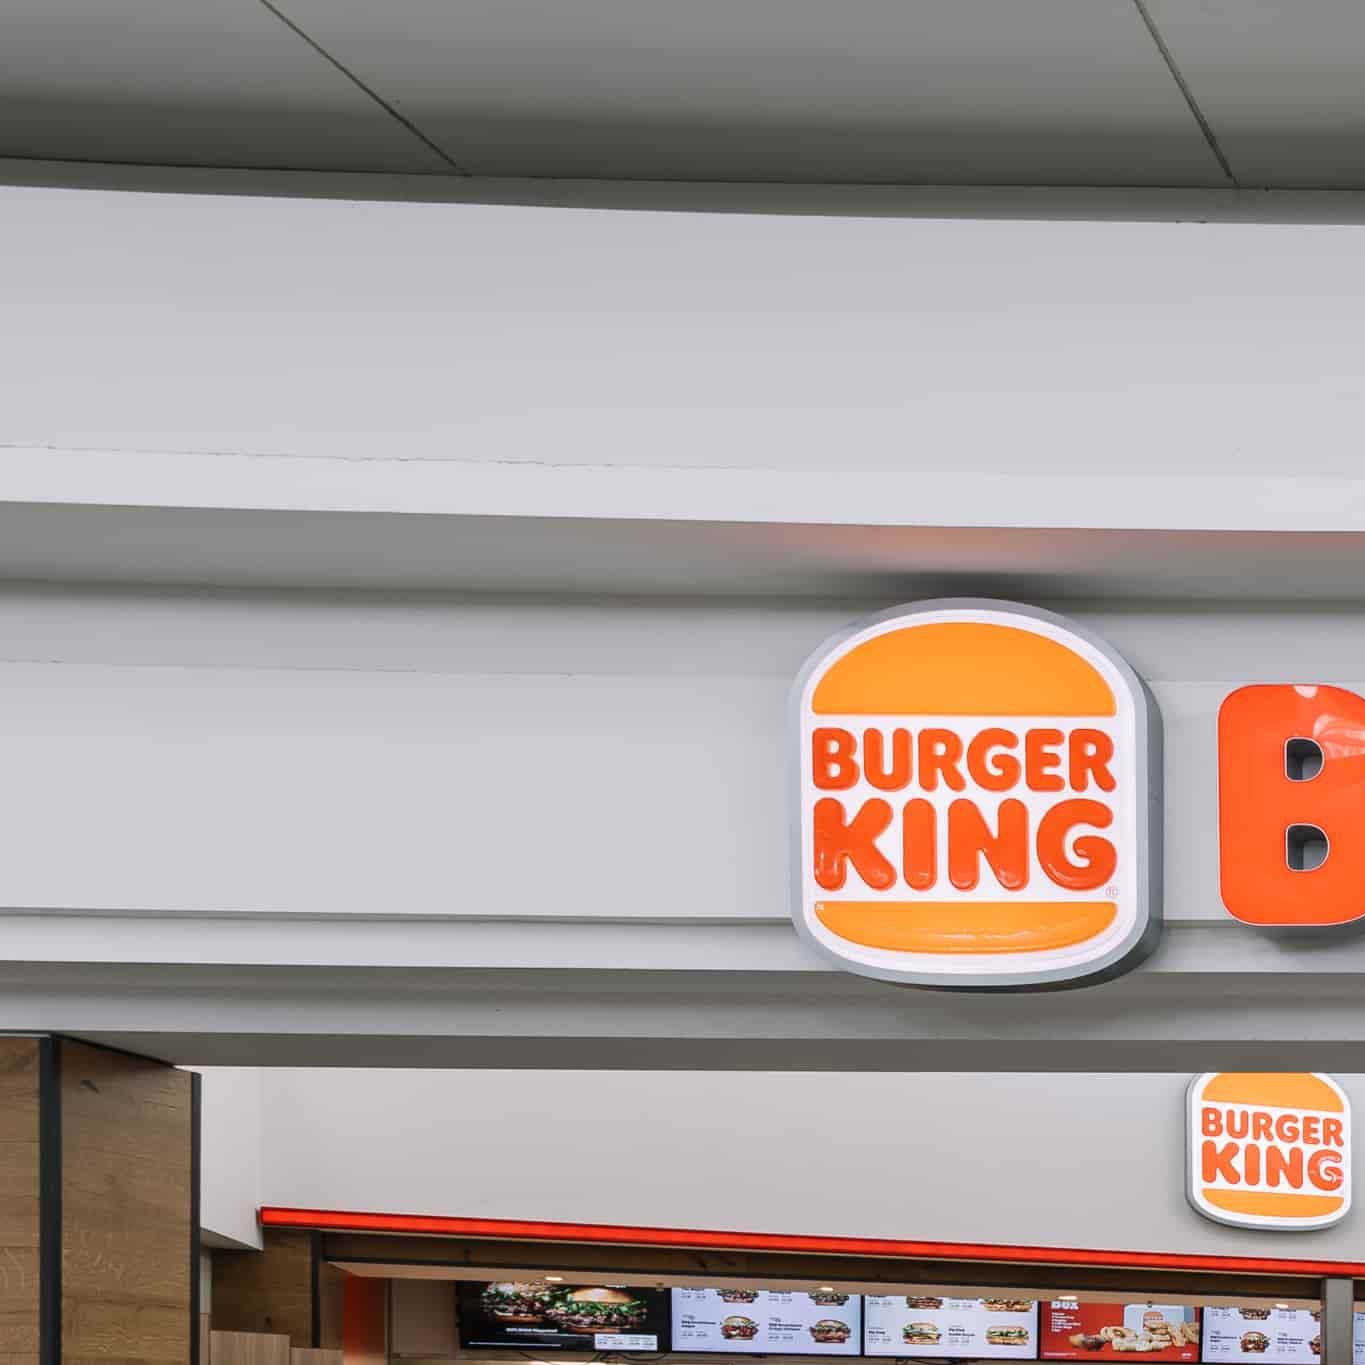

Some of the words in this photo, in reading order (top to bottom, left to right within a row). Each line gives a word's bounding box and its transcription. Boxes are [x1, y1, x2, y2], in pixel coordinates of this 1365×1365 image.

[811, 727, 1116, 792] BURGER
[813, 797, 1118, 892] KING
[1201, 1107, 1344, 1148] BURGER
[1201, 1140, 1344, 1192] KING
